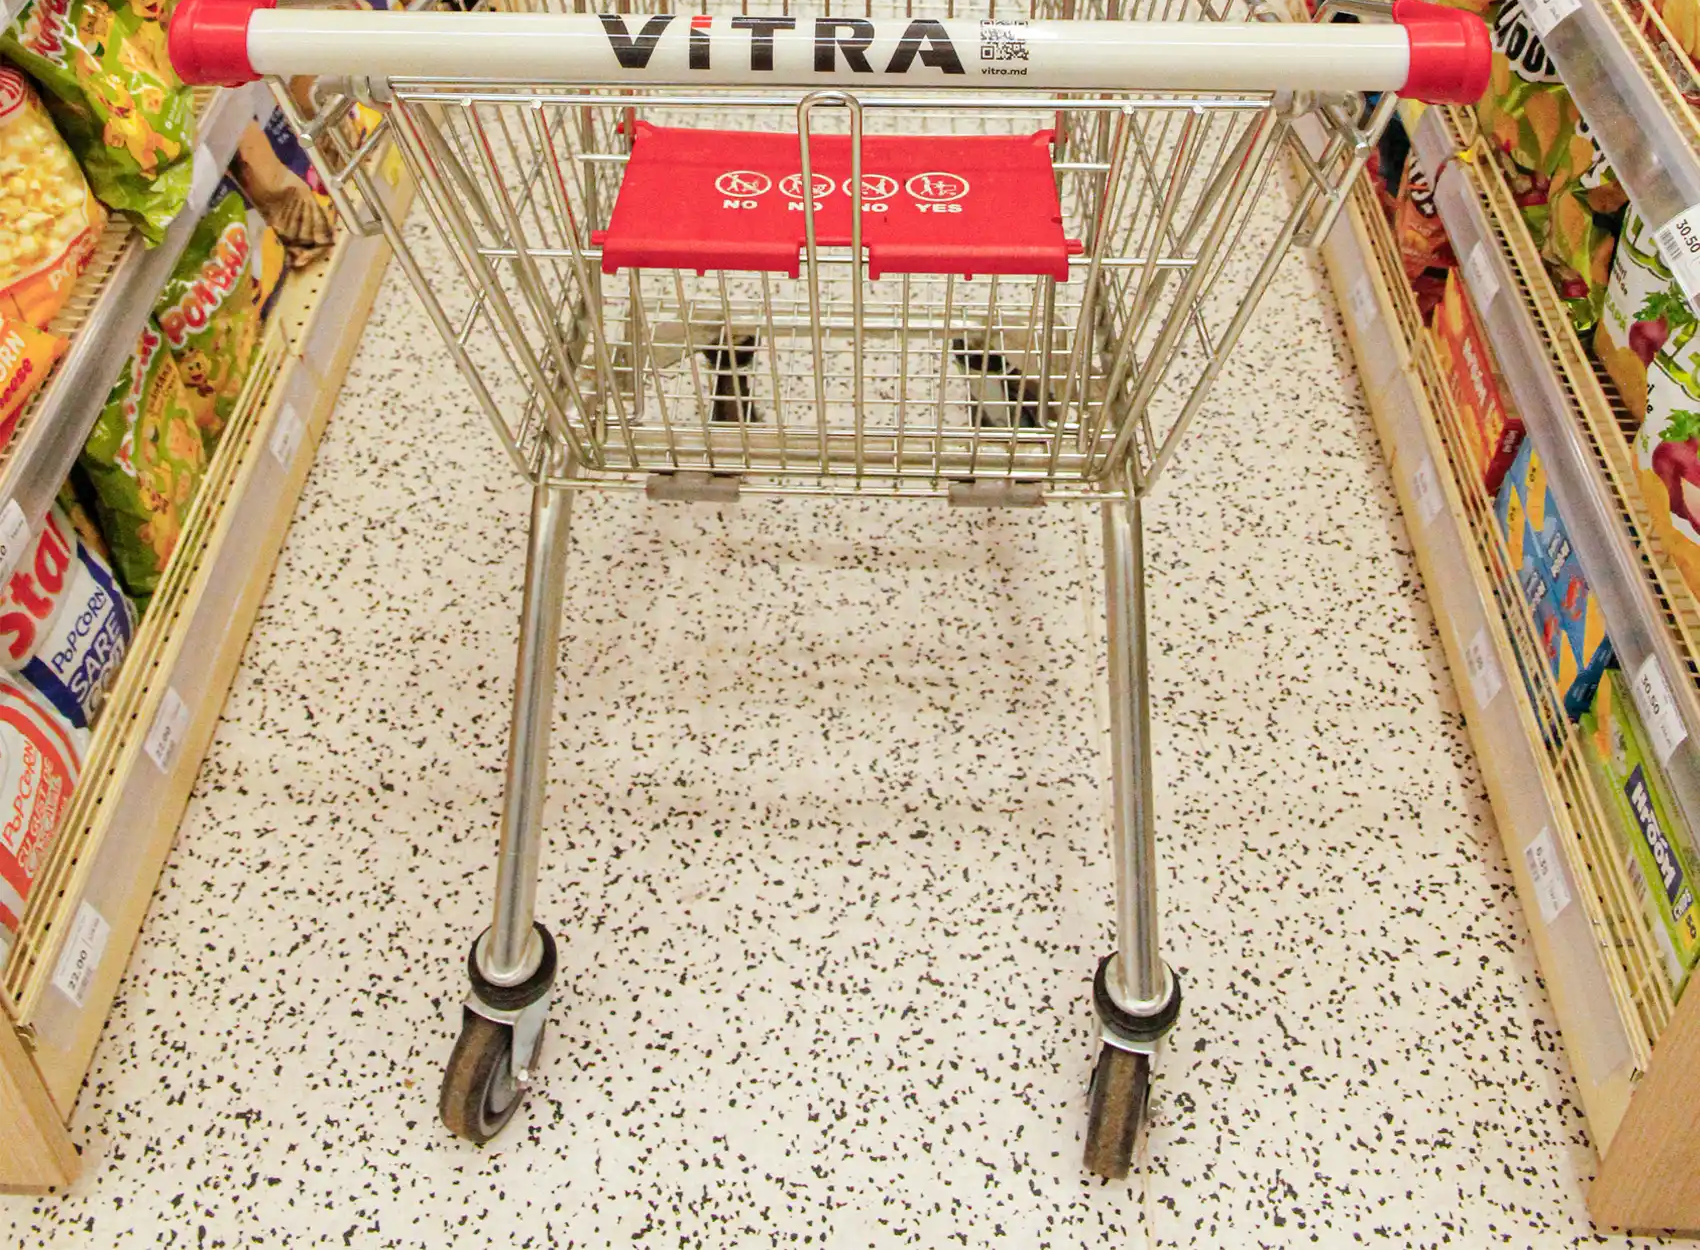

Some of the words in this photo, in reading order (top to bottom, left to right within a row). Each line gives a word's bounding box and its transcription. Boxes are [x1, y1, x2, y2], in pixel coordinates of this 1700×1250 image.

[723, 200, 758, 209] NO
[915, 203, 962, 213] YES
[1676, 218, 1700, 254] 30.50
[68, 948, 89, 991] 22.00
